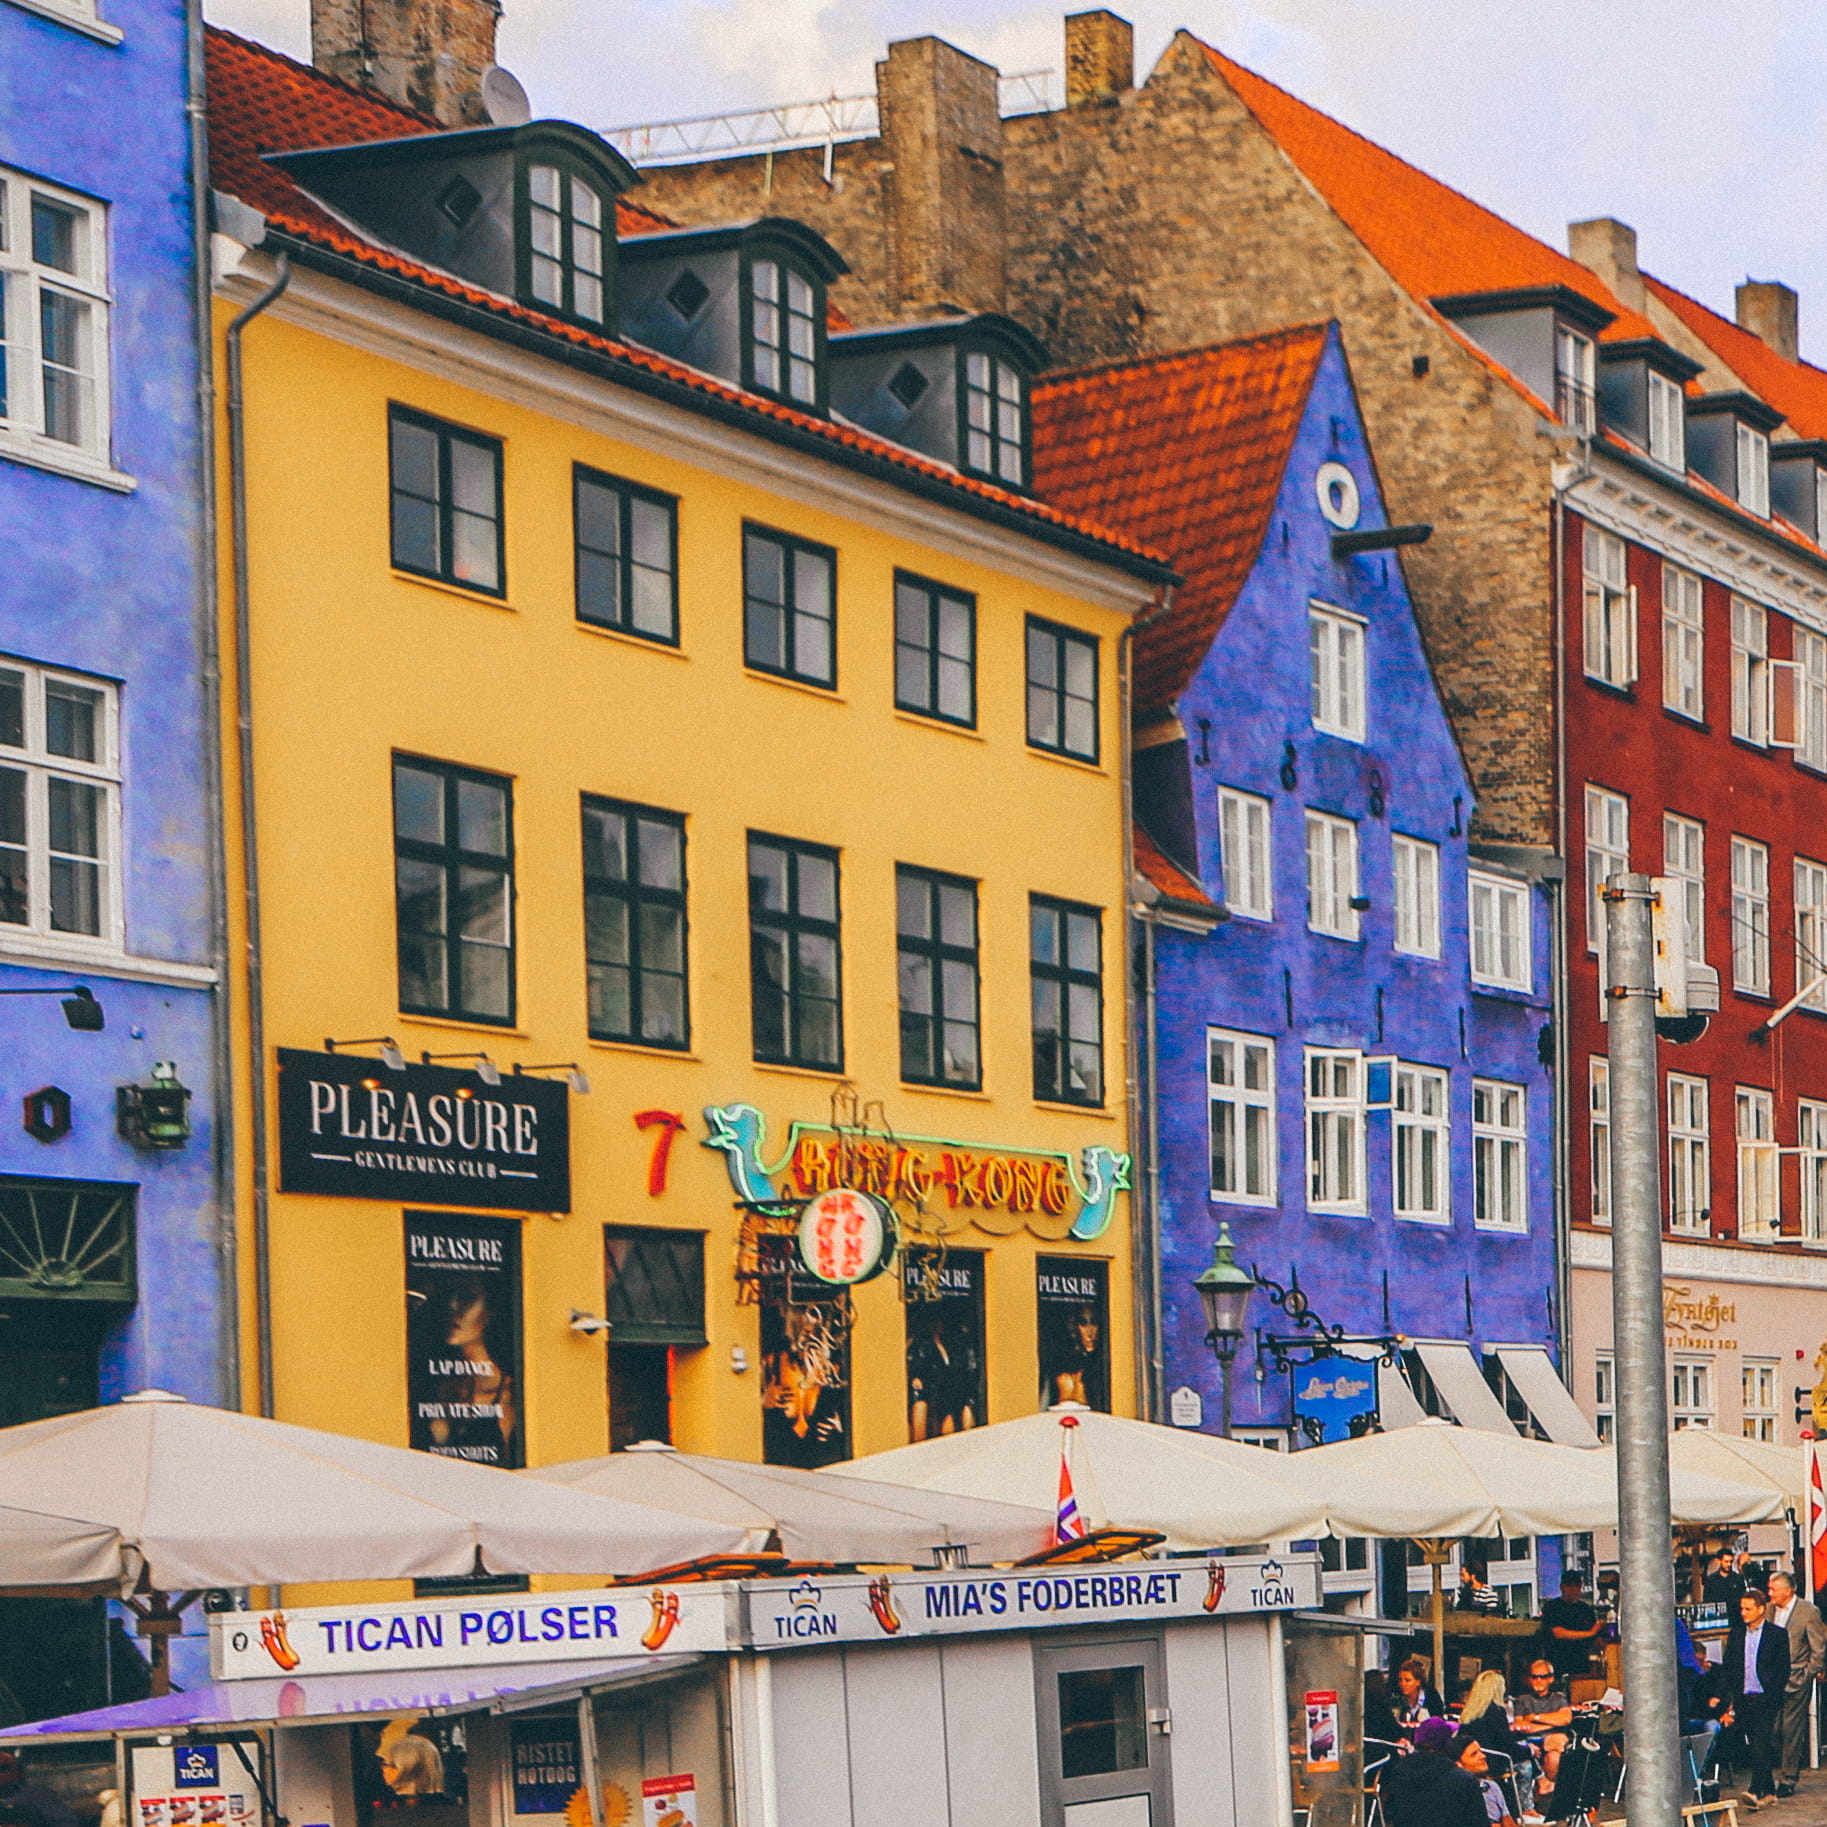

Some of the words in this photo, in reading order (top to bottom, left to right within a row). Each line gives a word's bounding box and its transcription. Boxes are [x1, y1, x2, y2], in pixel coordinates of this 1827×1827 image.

[309, 1080, 538, 1155] PLEASURE
[354, 1150, 456, 1176] GENTLEMENS
[458, 1160, 498, 1180] CLUB
[634, 1111, 687, 1197] 7
[410, 1234, 503, 1263] PLEASURE
[1039, 1274, 1097, 1297] PLEASURE
[428, 1359, 455, 1376] LAP
[774, 1613, 837, 1638] TICAN
[925, 1580, 1008, 1620] MIA'S
[1018, 1573, 1182, 1614] FODERBRÆT
[1251, 1586, 1295, 1608] TICAN
[318, 1614, 443, 1653] TICAN
[460, 1605, 619, 1646] PØLSER
[516, 1741, 574, 1763] RISTET
[180, 1767, 214, 1780] TICAN
[517, 1767, 576, 1785] HOTDOG
